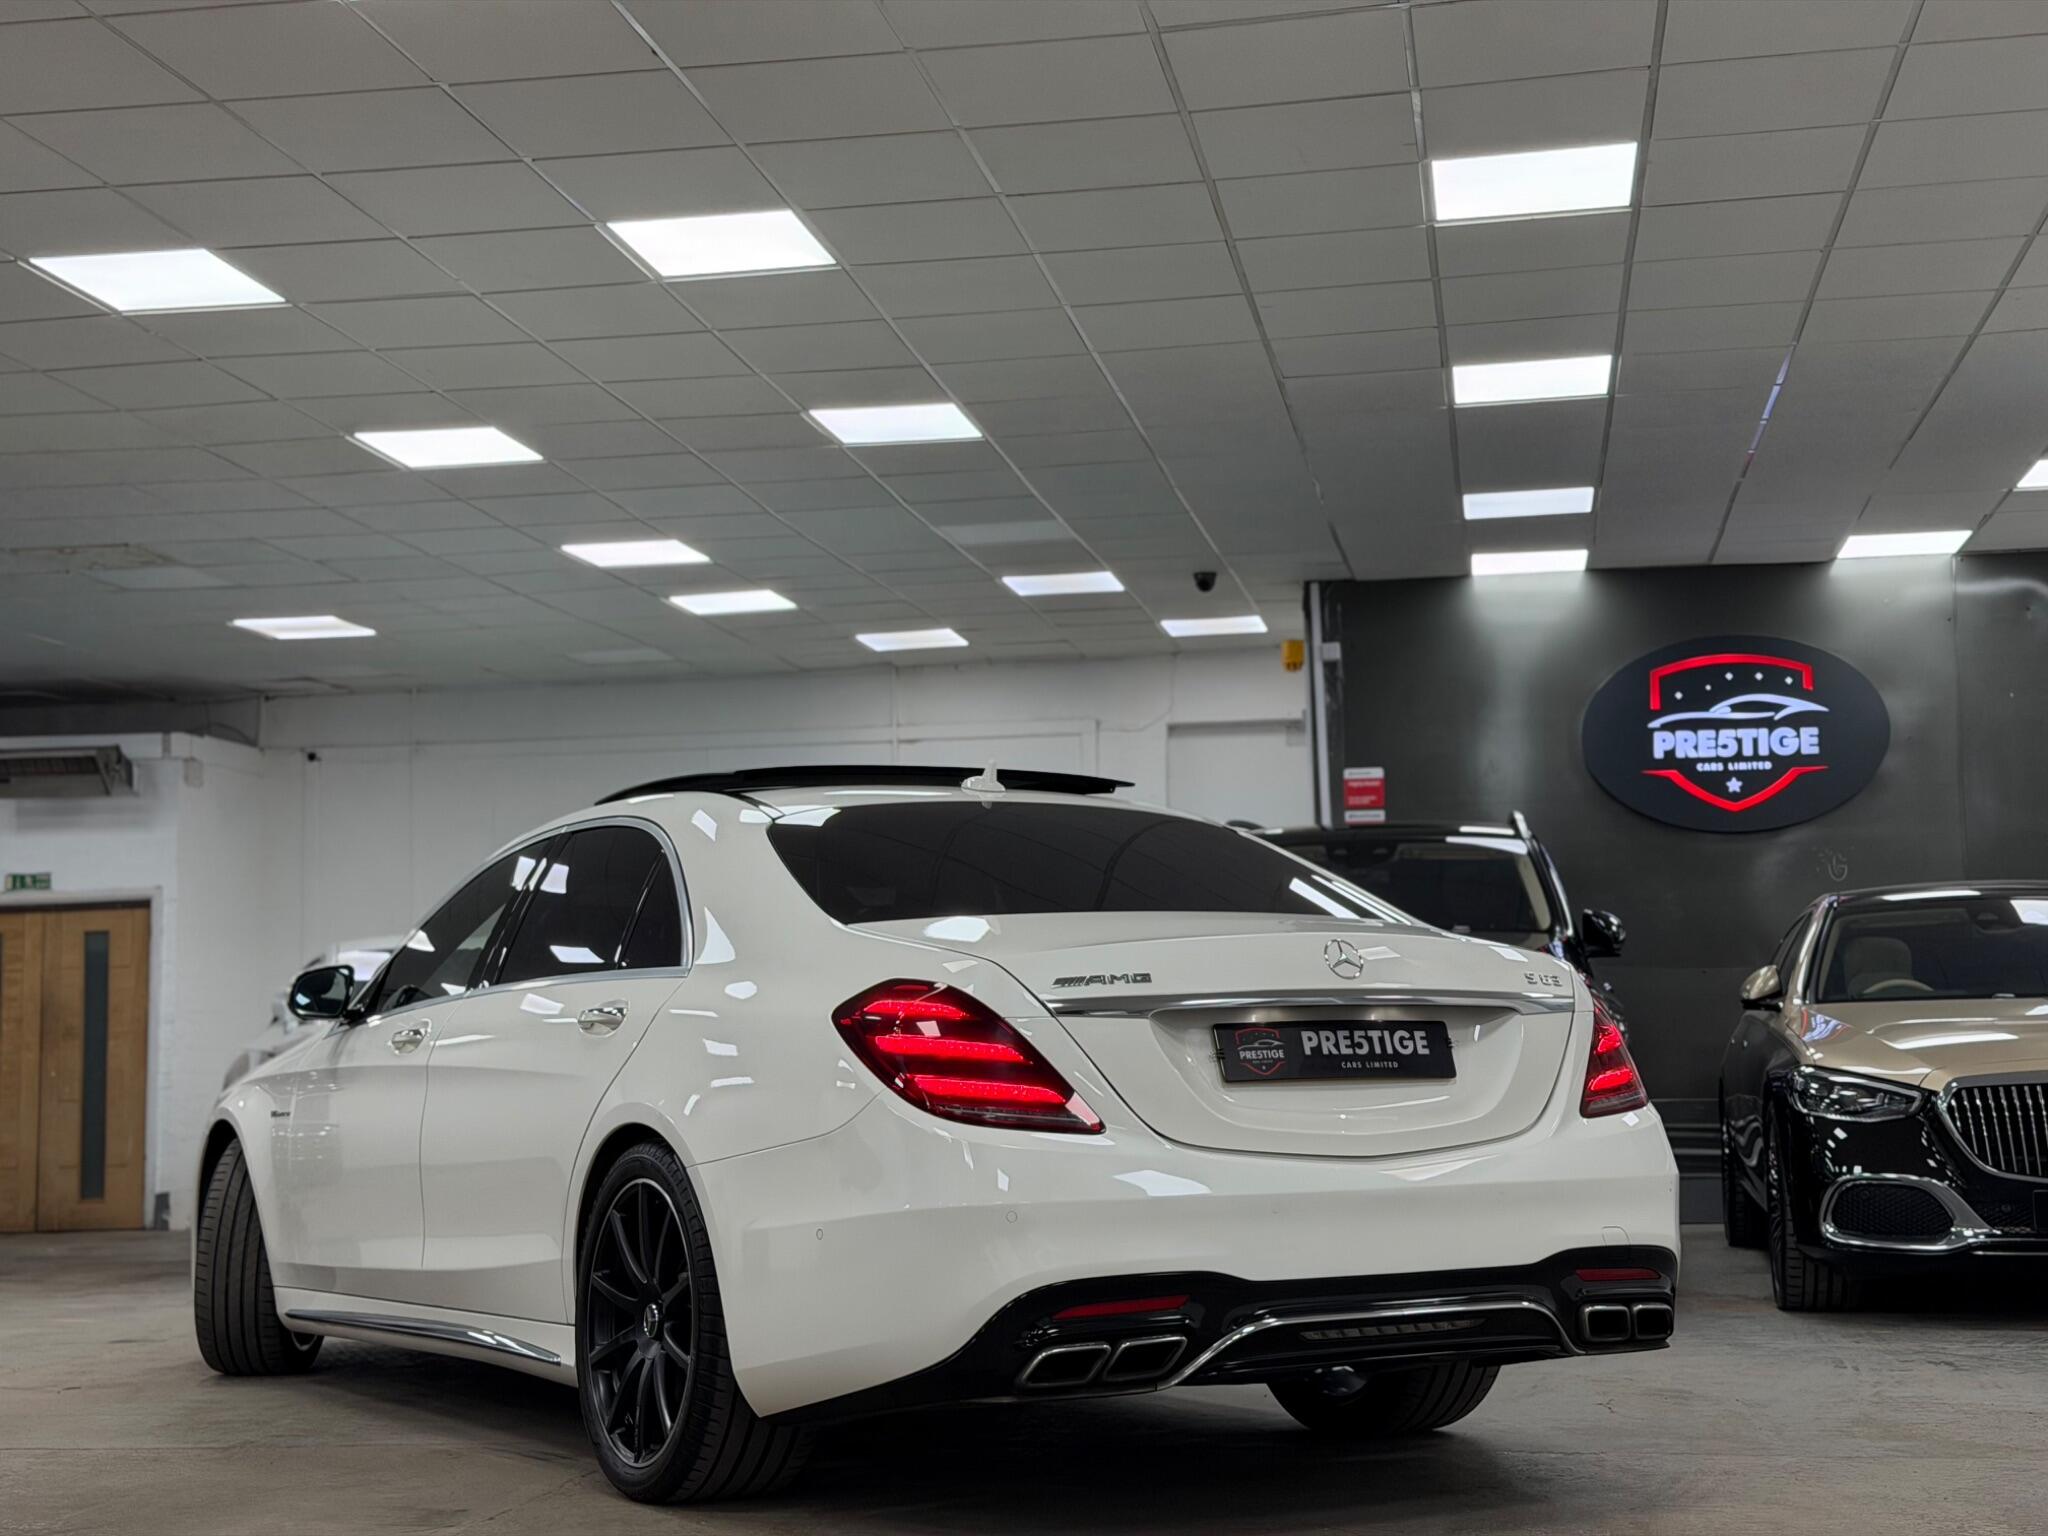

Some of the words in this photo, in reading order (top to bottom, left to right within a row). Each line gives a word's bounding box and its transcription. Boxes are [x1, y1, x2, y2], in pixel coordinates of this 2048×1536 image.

[1696, 761, 1724, 772] CARS
[1727, 760, 1773, 771] LIMITED
[1341, 1061, 1362, 1069] CARS
[1365, 1061, 1399, 1069] LIMITED
